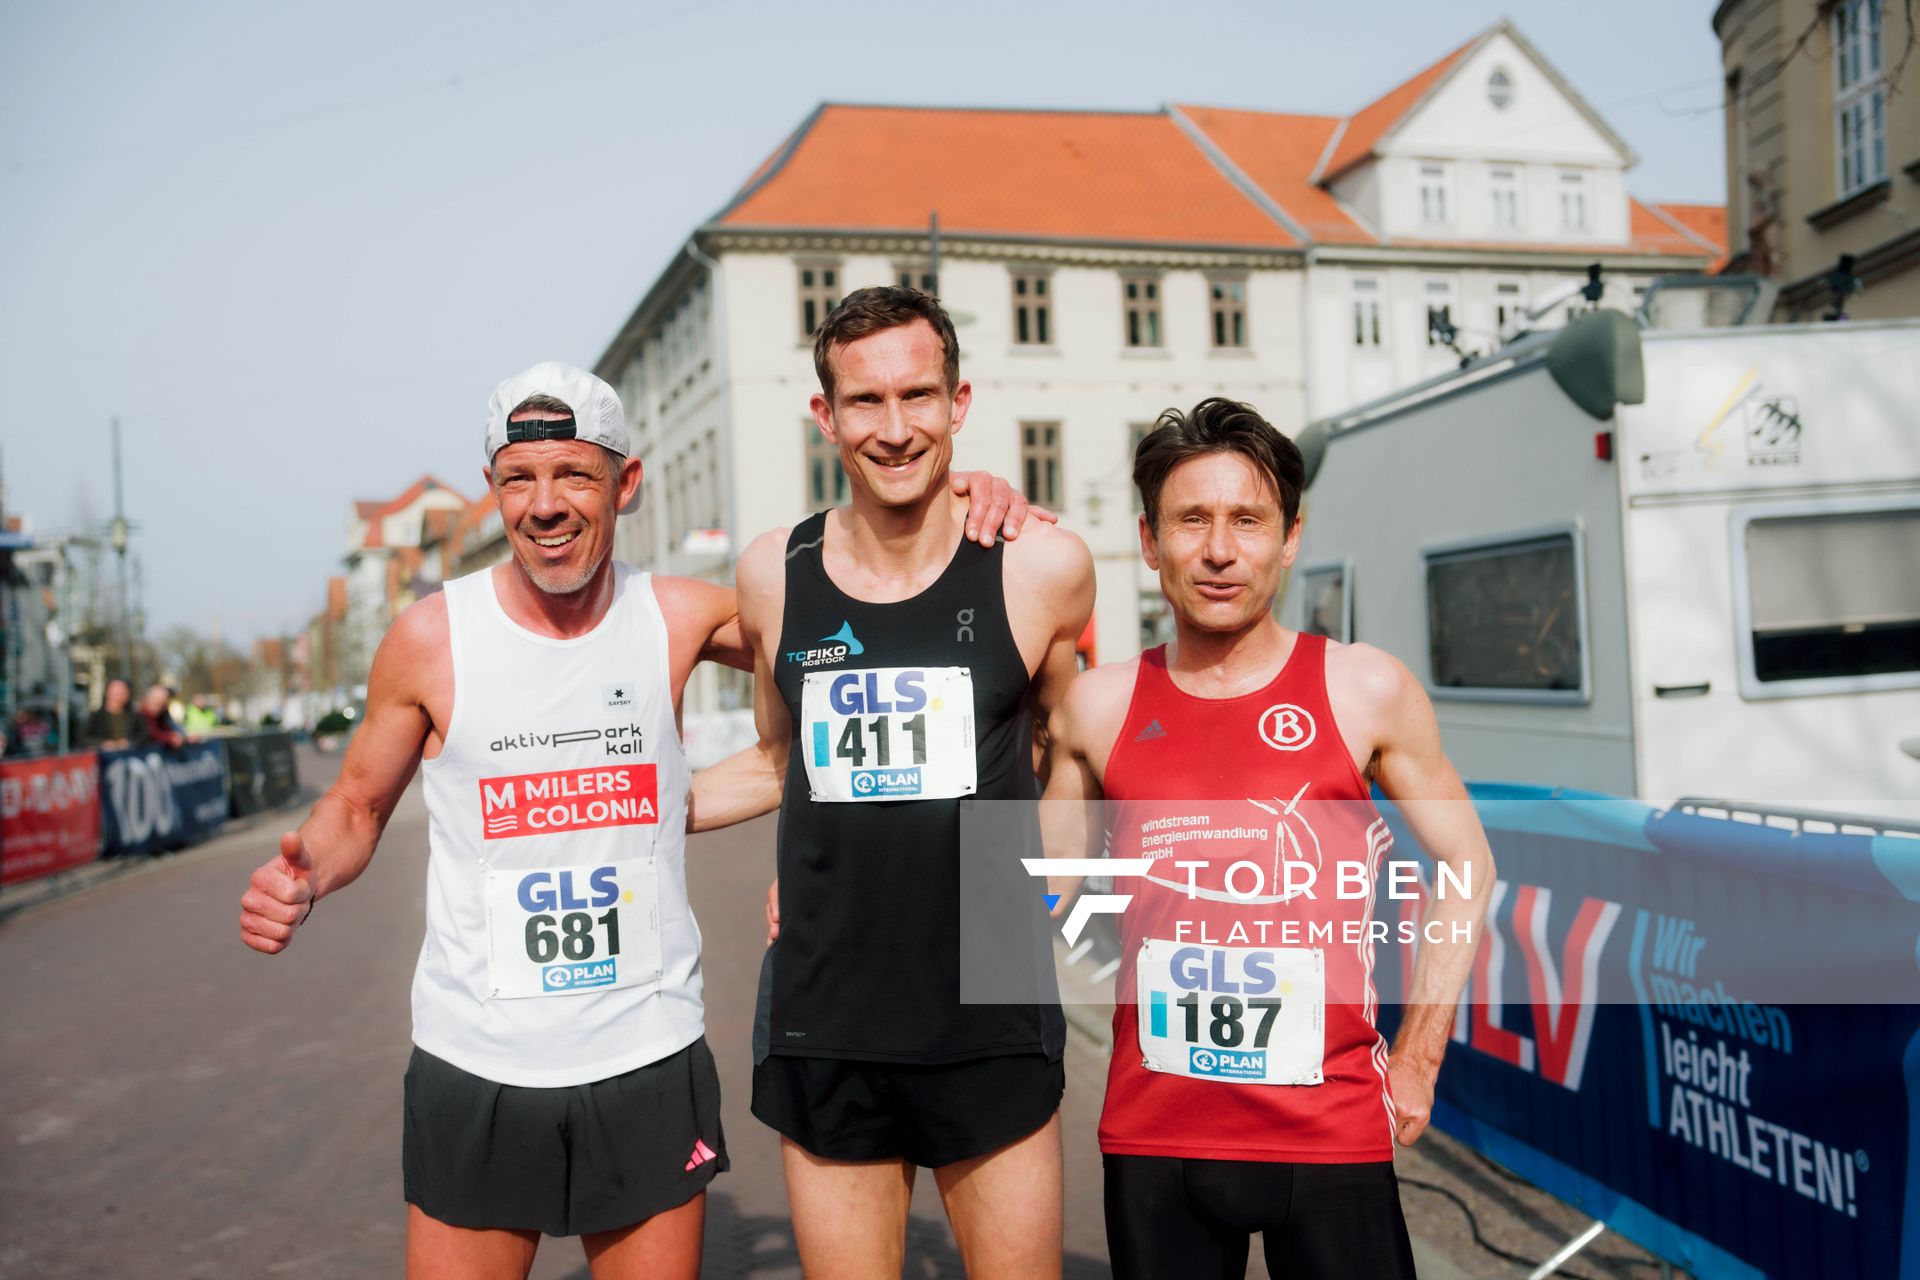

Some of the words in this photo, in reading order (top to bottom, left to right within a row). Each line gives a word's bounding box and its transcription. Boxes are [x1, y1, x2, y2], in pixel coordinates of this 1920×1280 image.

[801, 655, 846, 668] ROSTOCK
[607, 699, 632, 707] SAYSKY
[1272, 709, 1304, 744] B
[606, 739, 642, 755] kall
[836, 713, 927, 768] 411
[524, 770, 631, 801] MILERS
[877, 772, 919, 787] PLAN
[877, 786, 919, 794] INTERNATIONAL
[526, 796, 656, 829] COLONIA
[1141, 815, 1210, 833] windstream
[1141, 826, 1268, 849] Energieumwandlung
[524, 907, 620, 964] 681
[1652, 913, 1705, 978] Wir
[573, 963, 614, 980] PLAN
[574, 976, 614, 986] INTERNATIONAL
[1176, 992, 1282, 1048] 187
[1650, 973, 1793, 1054] machen
[1219, 1054, 1263, 1069] PLAN
[1661, 1022, 1751, 1108] leicht
[1219, 1068, 1263, 1076] INTERNATIONAL
